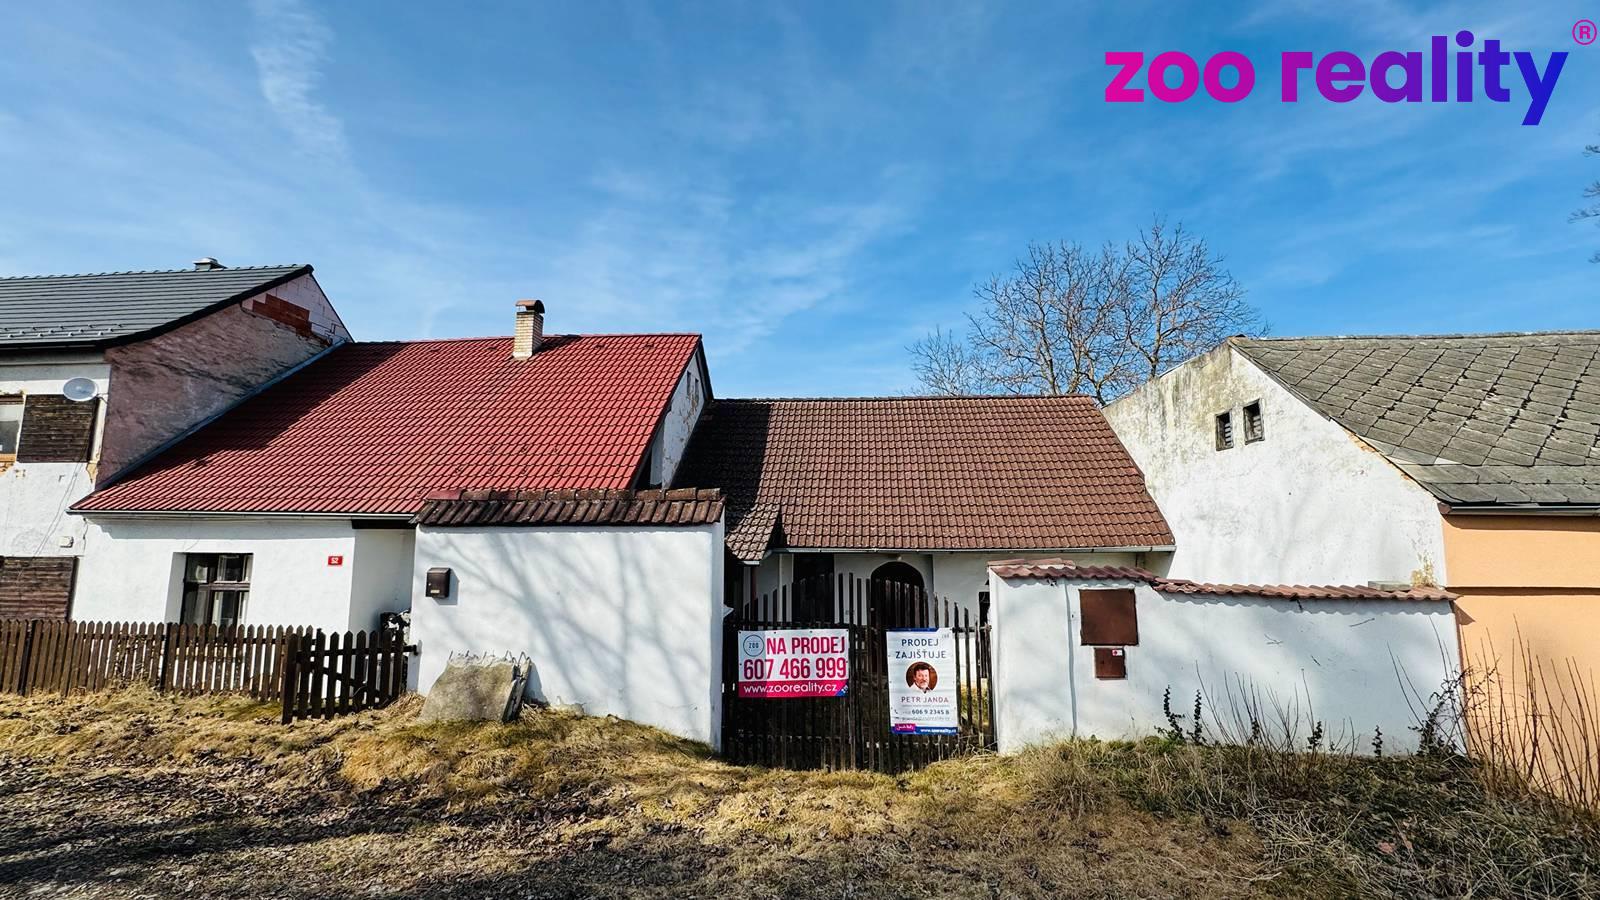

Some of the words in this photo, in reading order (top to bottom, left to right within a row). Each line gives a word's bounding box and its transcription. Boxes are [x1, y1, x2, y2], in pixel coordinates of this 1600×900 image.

[766, 637, 787, 655] NA
[791, 636, 845, 655] PRODEJ
[901, 638, 939, 647] PRODEJ
[895, 649, 946, 659] ZAJIŠŤUJE
[743, 658, 774, 680] 607
[779, 657, 811, 679] 466
[815, 657, 847, 679] 999
[743, 681, 838, 694] www.zooreality.cz
